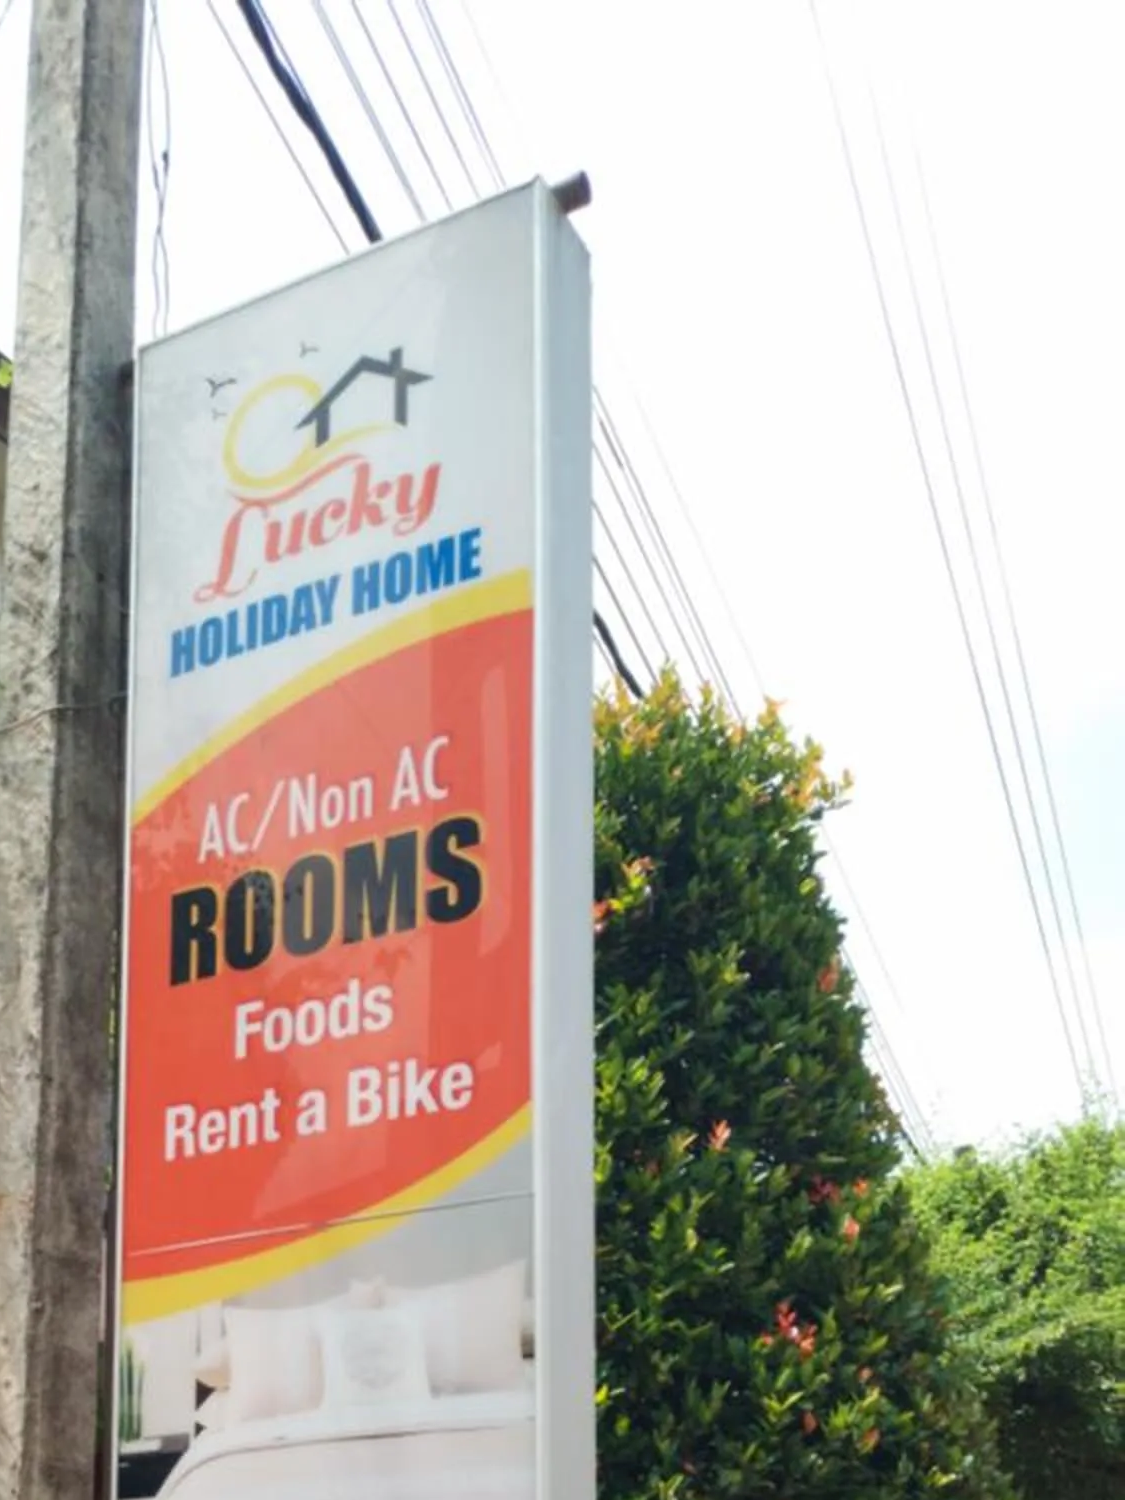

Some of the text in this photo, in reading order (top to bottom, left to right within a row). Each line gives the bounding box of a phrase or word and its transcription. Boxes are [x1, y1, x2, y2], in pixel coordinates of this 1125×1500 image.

[193, 454, 442, 604] Lucky
[169, 527, 482, 678] HOLIDAY HOME
[197, 736, 450, 863] AC/Non AC
[169, 816, 483, 987] ROOMS
[235, 978, 394, 1059] Foods
[164, 1058, 474, 1161] Rent a Bike
